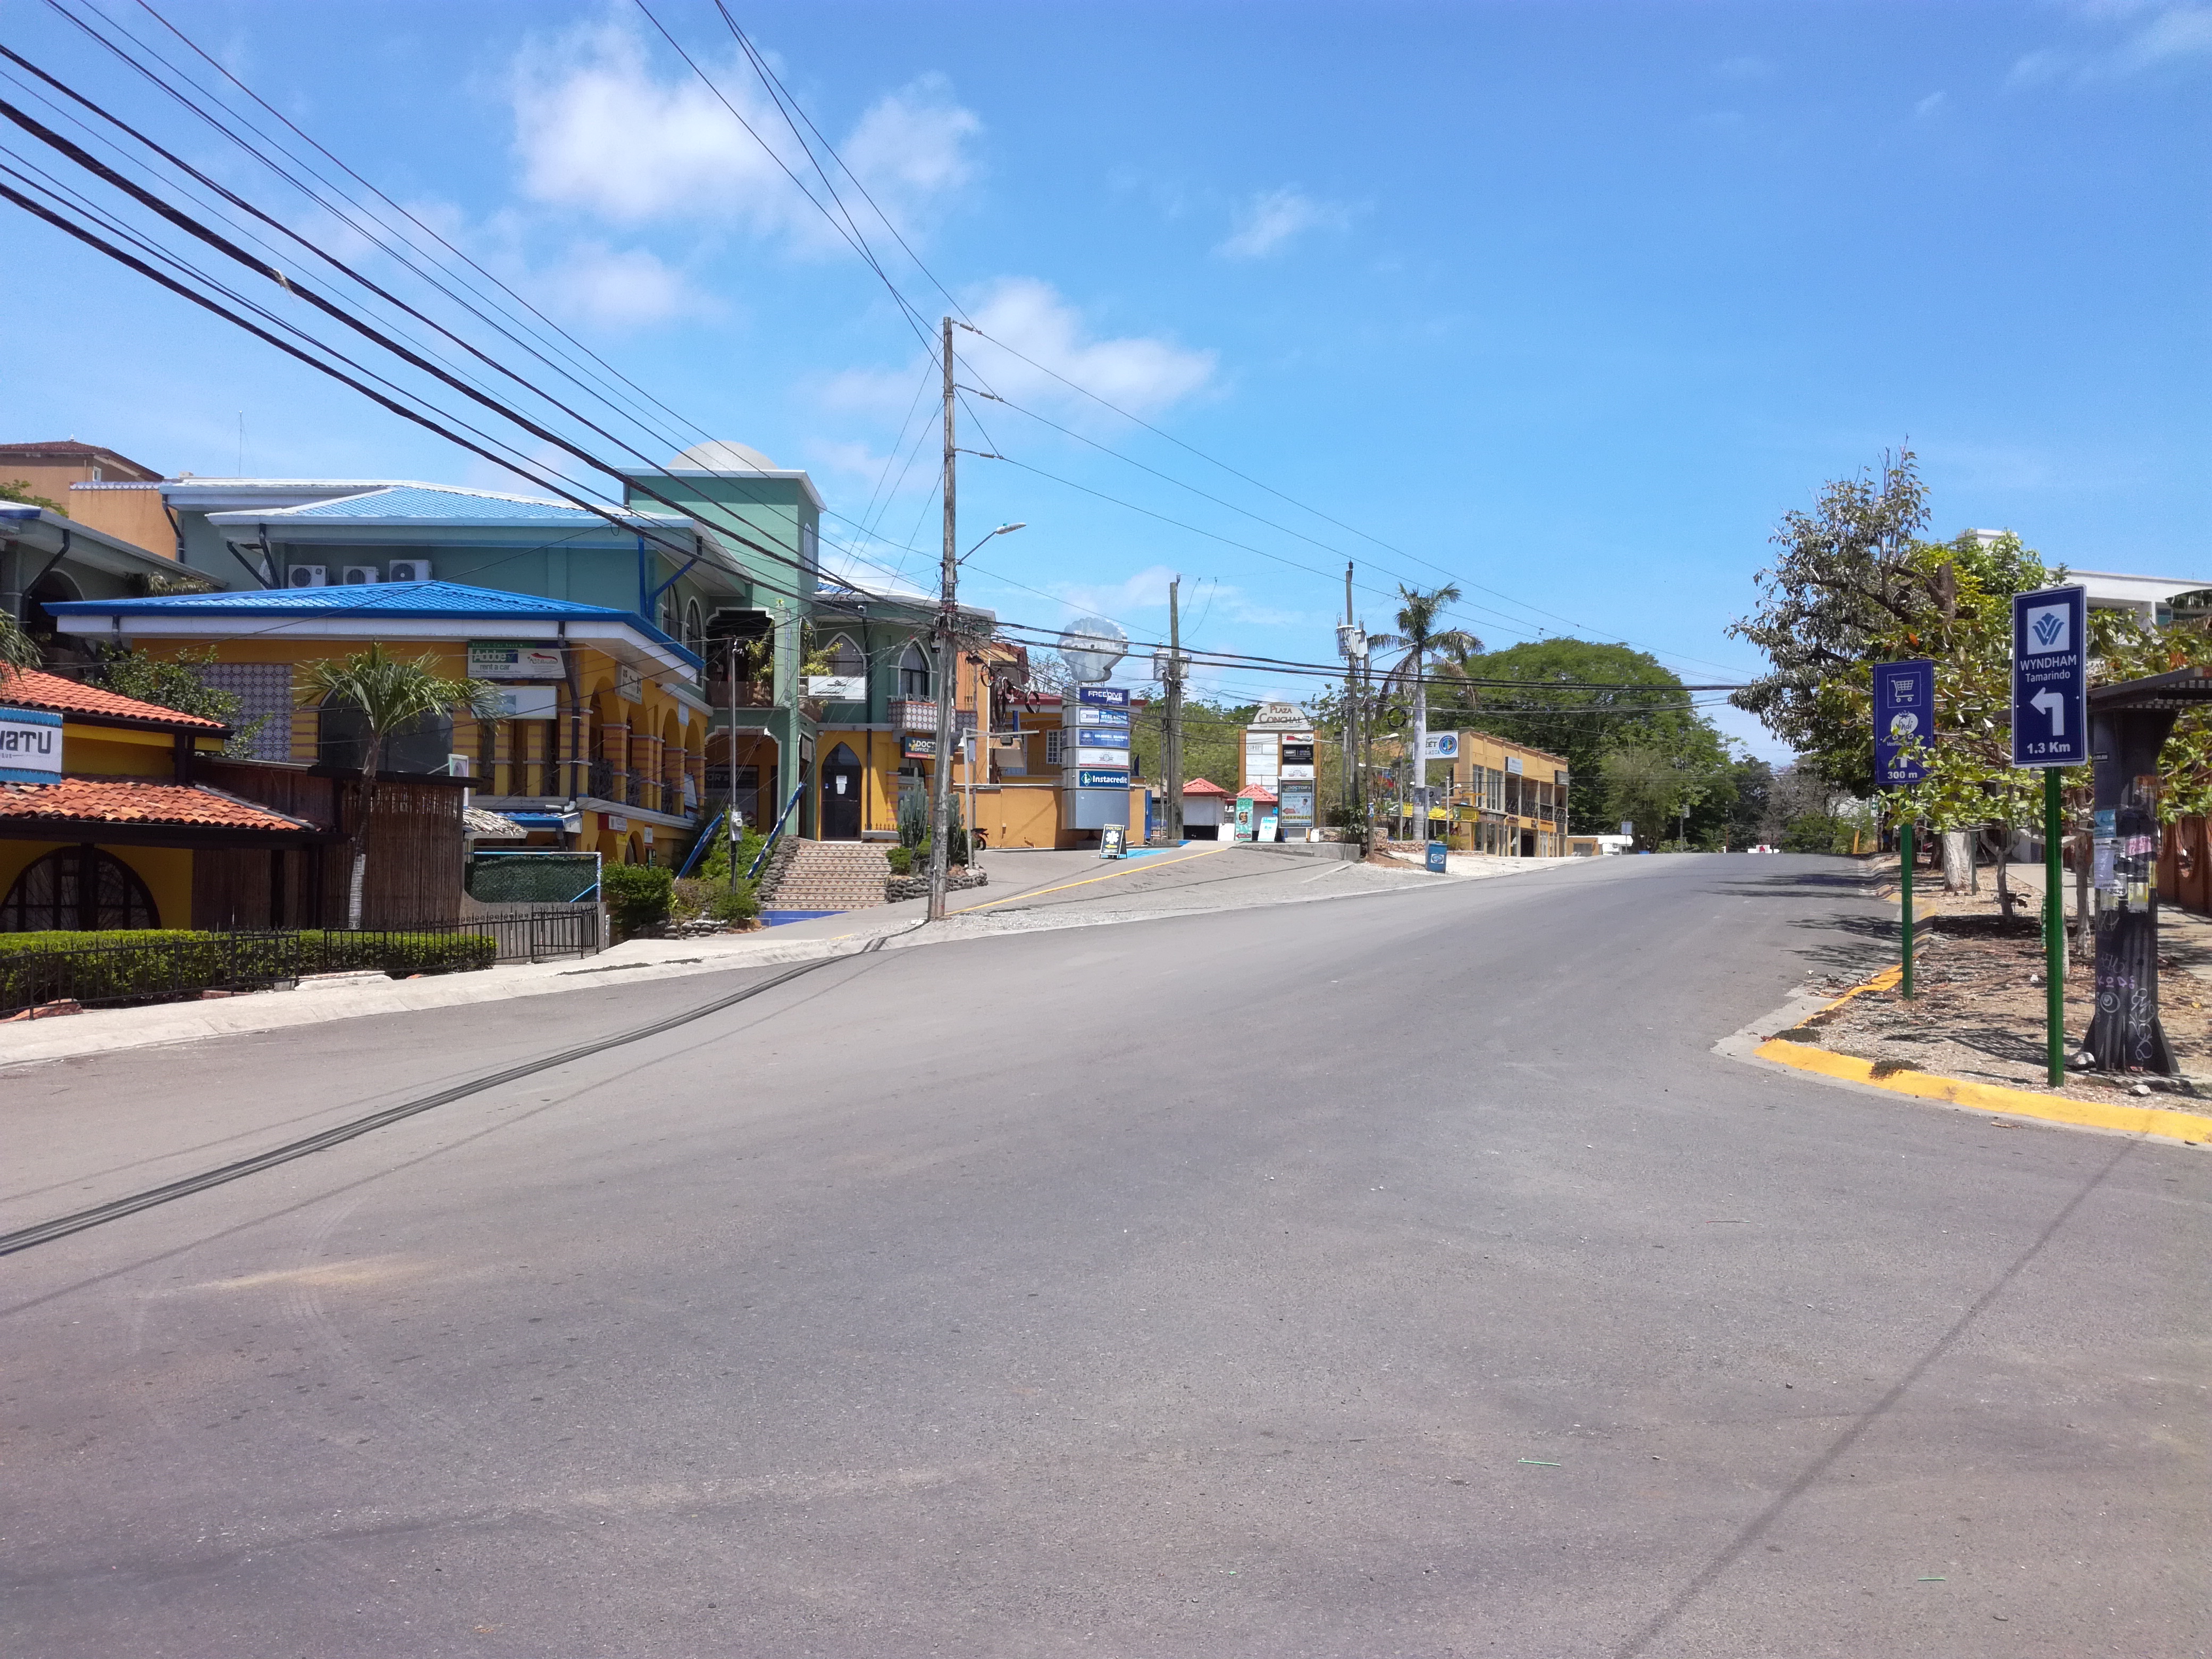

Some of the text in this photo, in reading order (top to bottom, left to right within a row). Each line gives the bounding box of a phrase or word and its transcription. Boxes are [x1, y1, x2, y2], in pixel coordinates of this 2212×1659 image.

[474, 650, 507, 661] Adobe
[2021, 655, 2077, 671] WYNDHAM
[2025, 669, 2071, 682] Tamarindo
[1270, 705, 1293, 714] PLAZA
[1259, 713, 1303, 723] CONCHAL
[2027, 741, 2071, 754] 1.3 Km
[1093, 775, 1127, 784] Instacredit
[1888, 771, 1905, 780] 300
